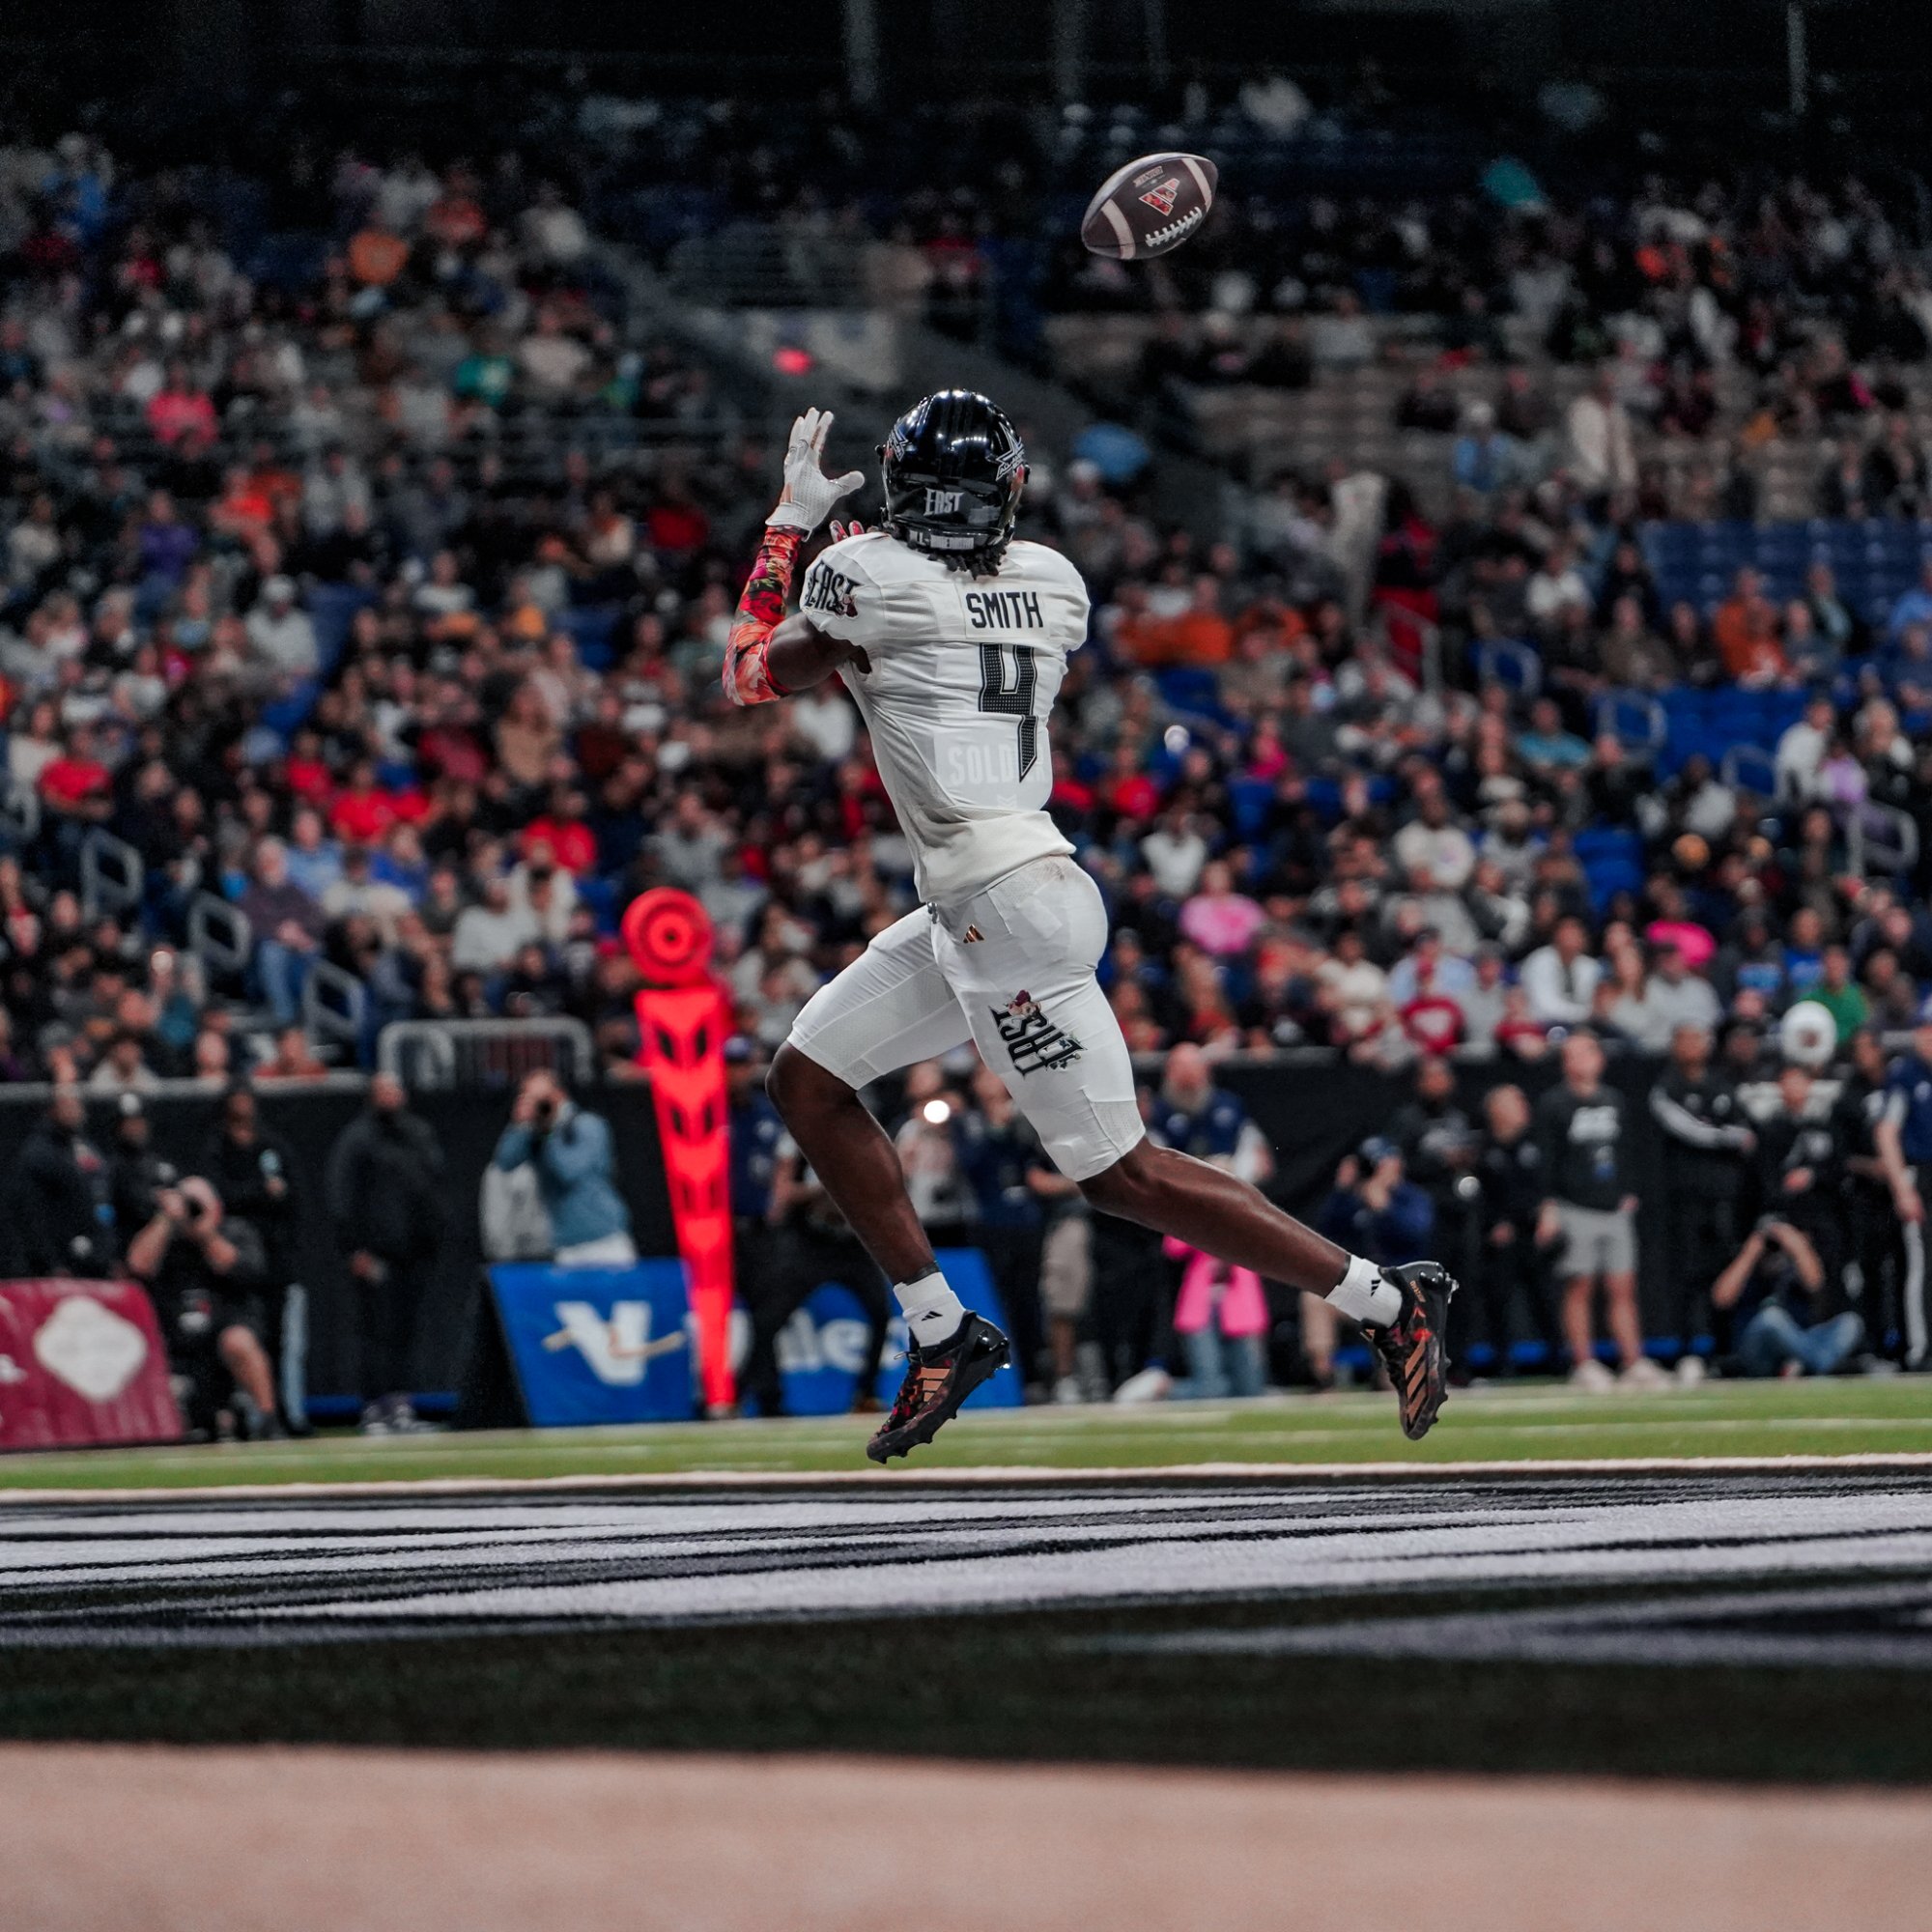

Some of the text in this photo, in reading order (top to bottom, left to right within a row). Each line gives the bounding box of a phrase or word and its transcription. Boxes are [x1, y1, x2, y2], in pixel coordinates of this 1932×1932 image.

[923, 487, 964, 517] EAST
[966, 591, 1043, 629] SMITH
[979, 641, 1037, 783] 4
[947, 743, 1047, 786] SOLDR
